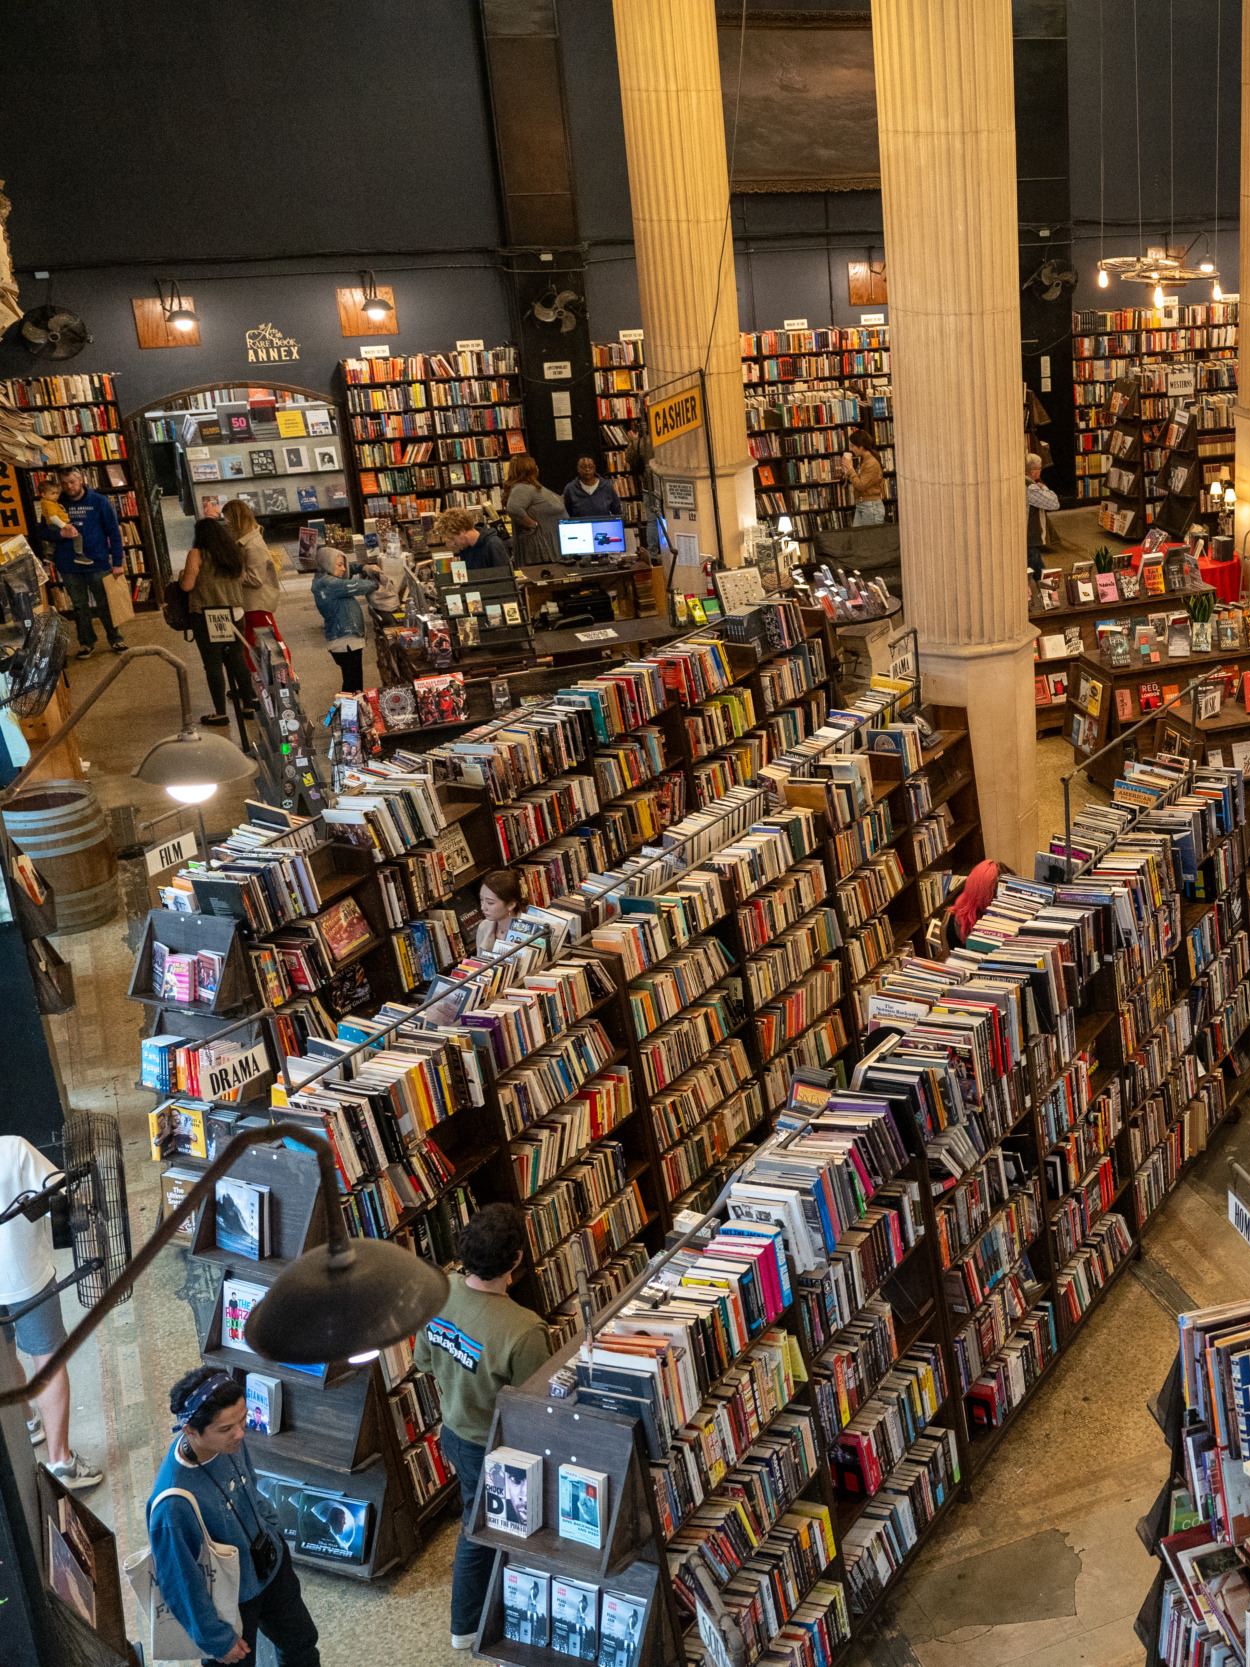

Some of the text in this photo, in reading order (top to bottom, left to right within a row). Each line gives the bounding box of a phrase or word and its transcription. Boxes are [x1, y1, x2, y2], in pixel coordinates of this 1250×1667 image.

[248, 346, 300, 362] ANNEX
[1169, 380, 1193, 389] WESTERNS
[231, 417, 247, 428] 50
[654, 395, 698, 437] CASHIER
[208, 612, 230, 624] THANK
[214, 622, 228, 633] YOU
[1141, 684, 1158, 692] RED
[1118, 789, 1152, 802] AMERICAN
[159, 841, 184, 868] FILM
[895, 1008, 919, 1018] Rockwell
[209, 1052, 261, 1095] DRAMA
[172, 1186, 185, 1194] The
[237, 1298, 251, 1309] THE
[427, 1331, 474, 1369] patagonia
[486, 1483, 504, 1496] CHUCK
[487, 1491, 504, 1515] D
[300, 1541, 354, 1558] LIGHTYEAR
